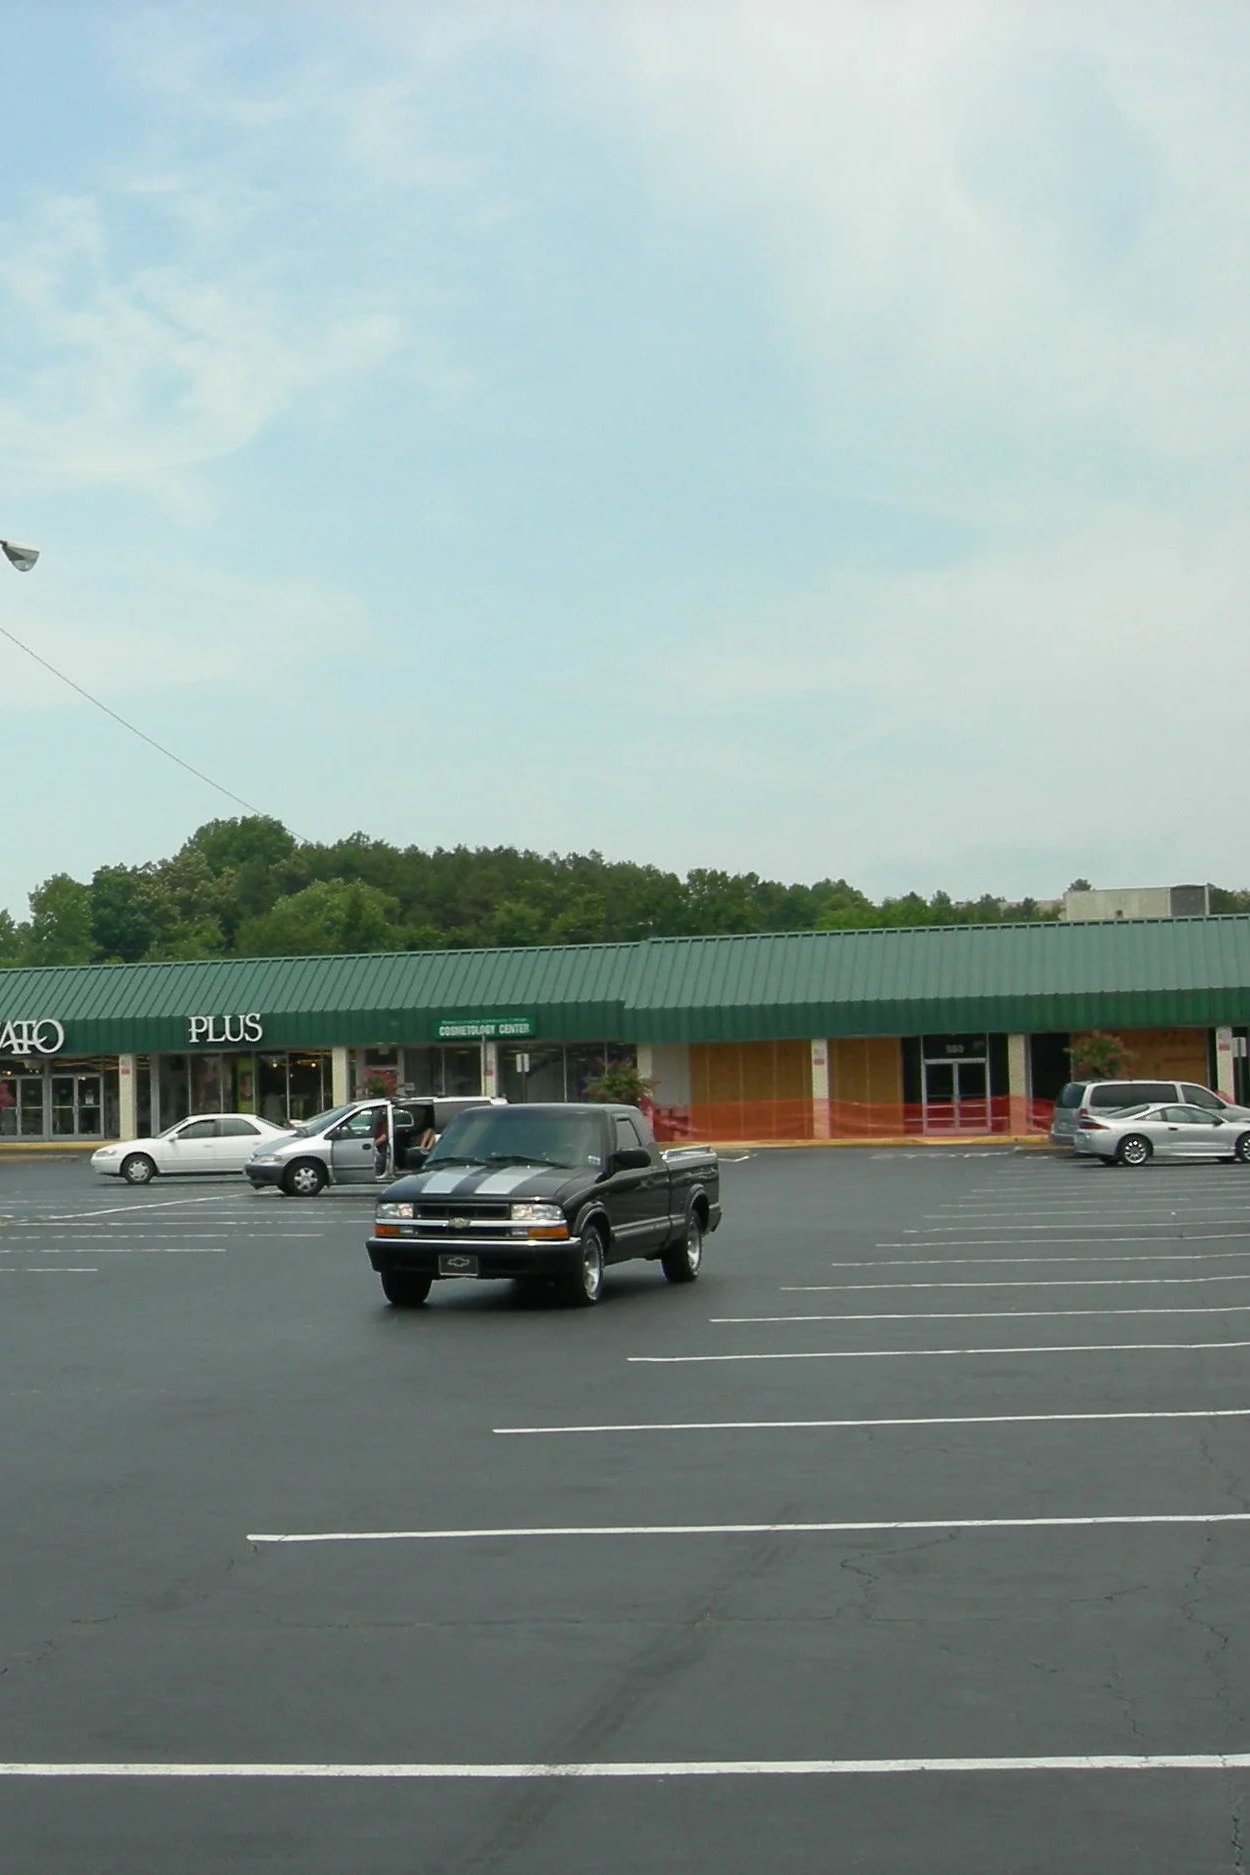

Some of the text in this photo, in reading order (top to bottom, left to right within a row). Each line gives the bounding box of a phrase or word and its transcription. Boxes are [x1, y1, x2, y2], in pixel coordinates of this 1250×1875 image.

[188, 1012, 263, 1043] PLUS
[438, 1022, 531, 1037] COSMETOLOGY CENTER
